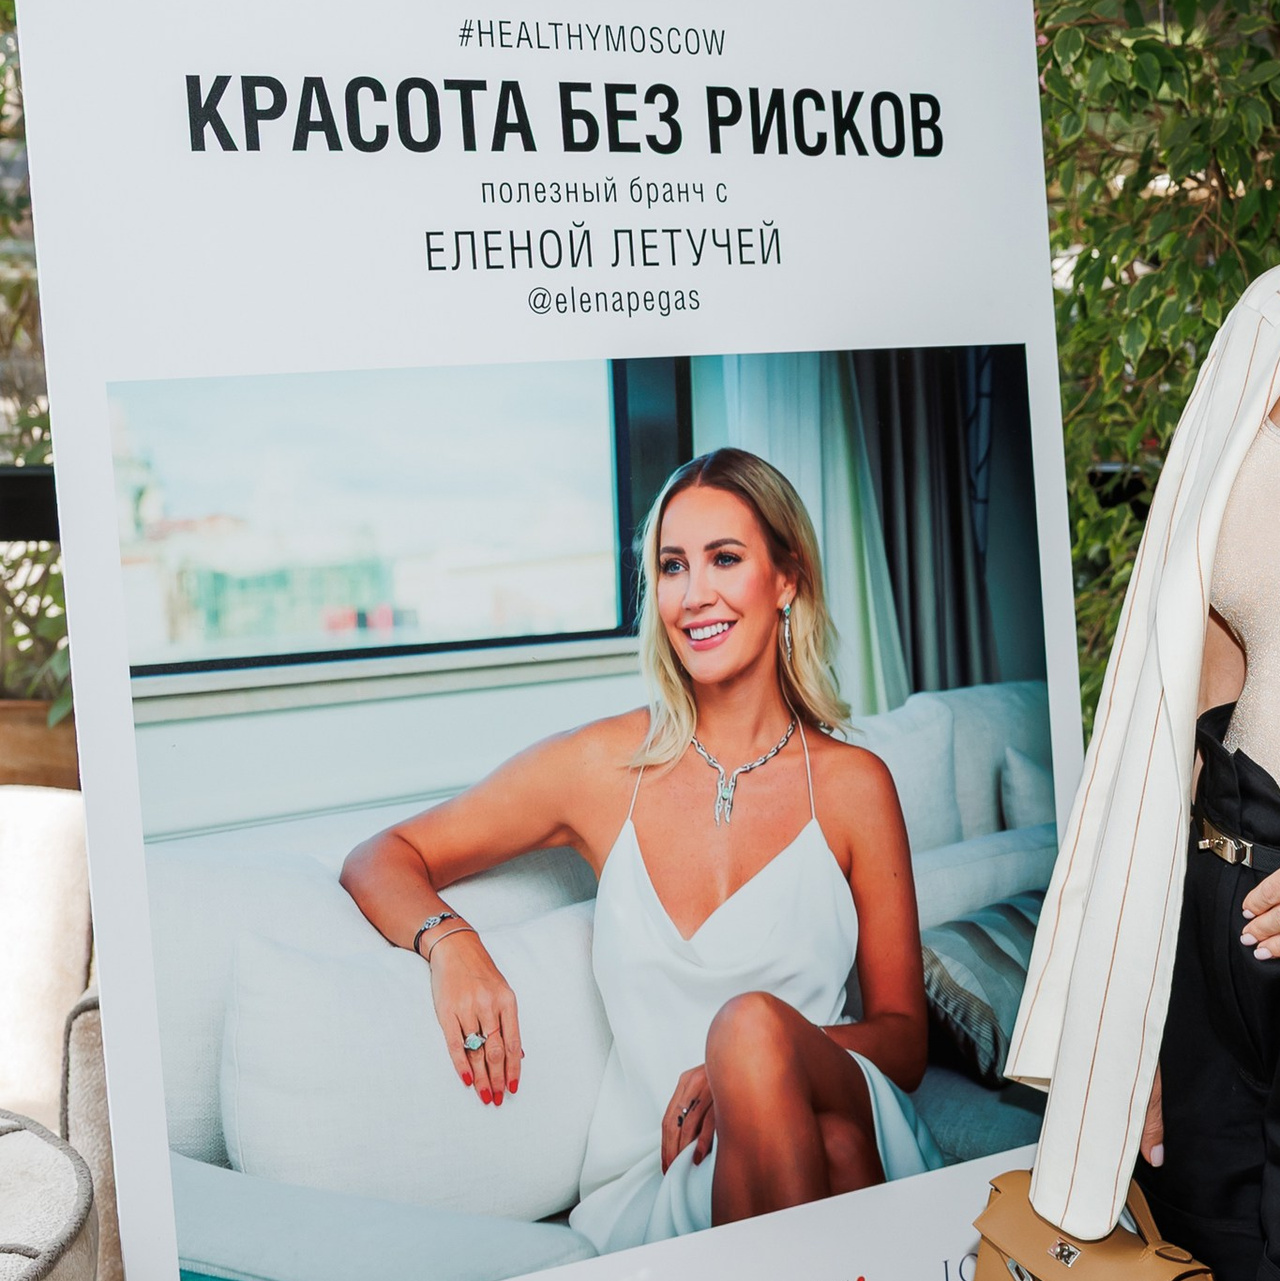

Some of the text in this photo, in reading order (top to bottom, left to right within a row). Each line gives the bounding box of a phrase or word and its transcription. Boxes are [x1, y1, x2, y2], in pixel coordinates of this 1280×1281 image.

[458, 18, 726, 56] #HEALTHYMOSCOW
[185, 74, 944, 159] КРАСОТА БЕЗ РИСКОВ
[481, 176, 729, 210] полезный бранч с
[424, 219, 782, 272] ЕЛЕНОЙ ЛЕТУЧЕЙ
[527, 286, 701, 318] @elenapegas
